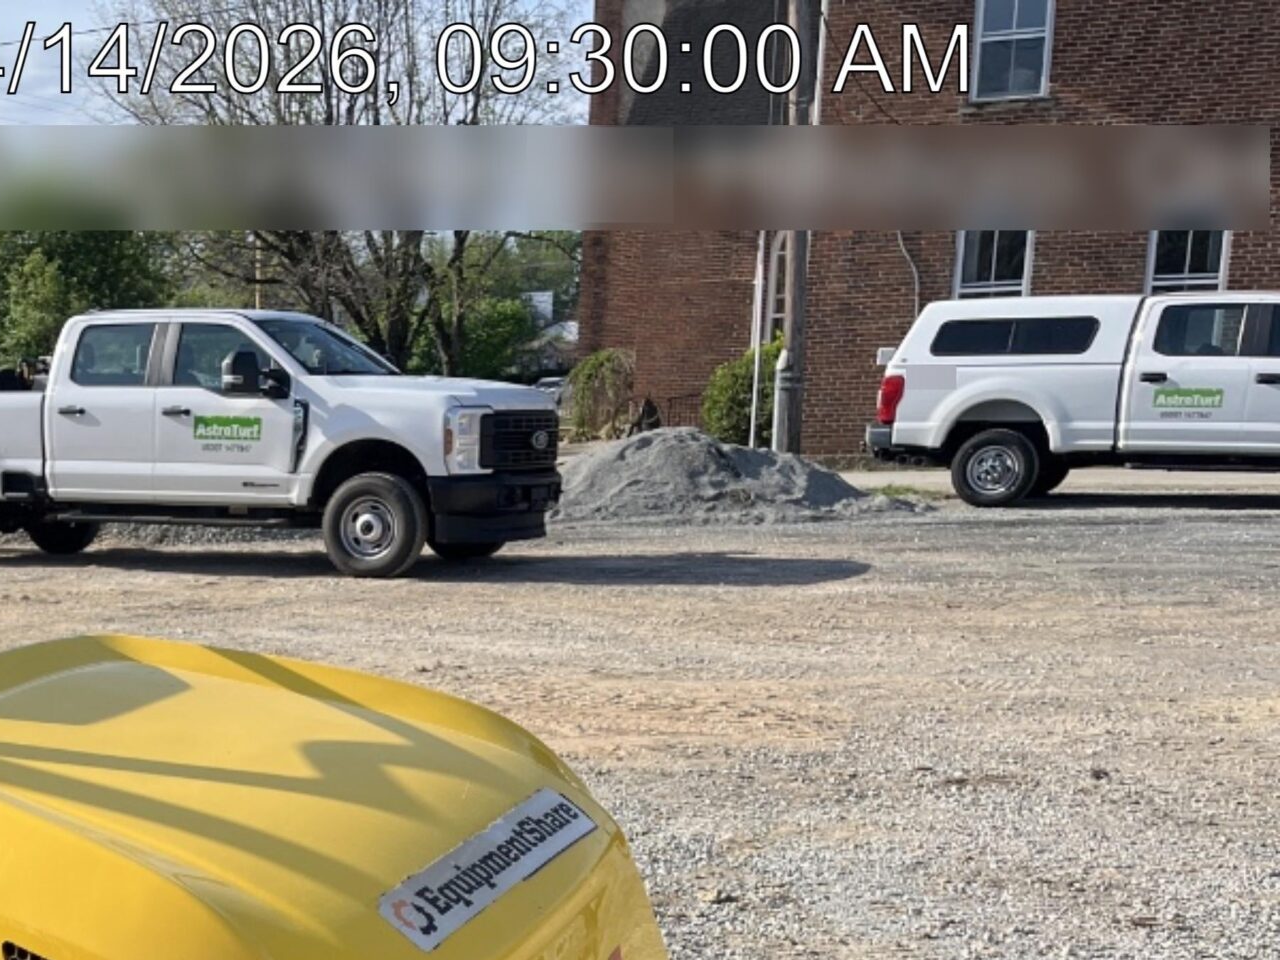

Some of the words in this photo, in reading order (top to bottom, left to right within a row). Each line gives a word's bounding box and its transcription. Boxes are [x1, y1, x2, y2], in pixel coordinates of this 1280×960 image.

[1155, 393, 1221, 405] AstroTurf
[196, 423, 259, 437] AstroTurf
[415, 802, 578, 915] EquipmentShare
